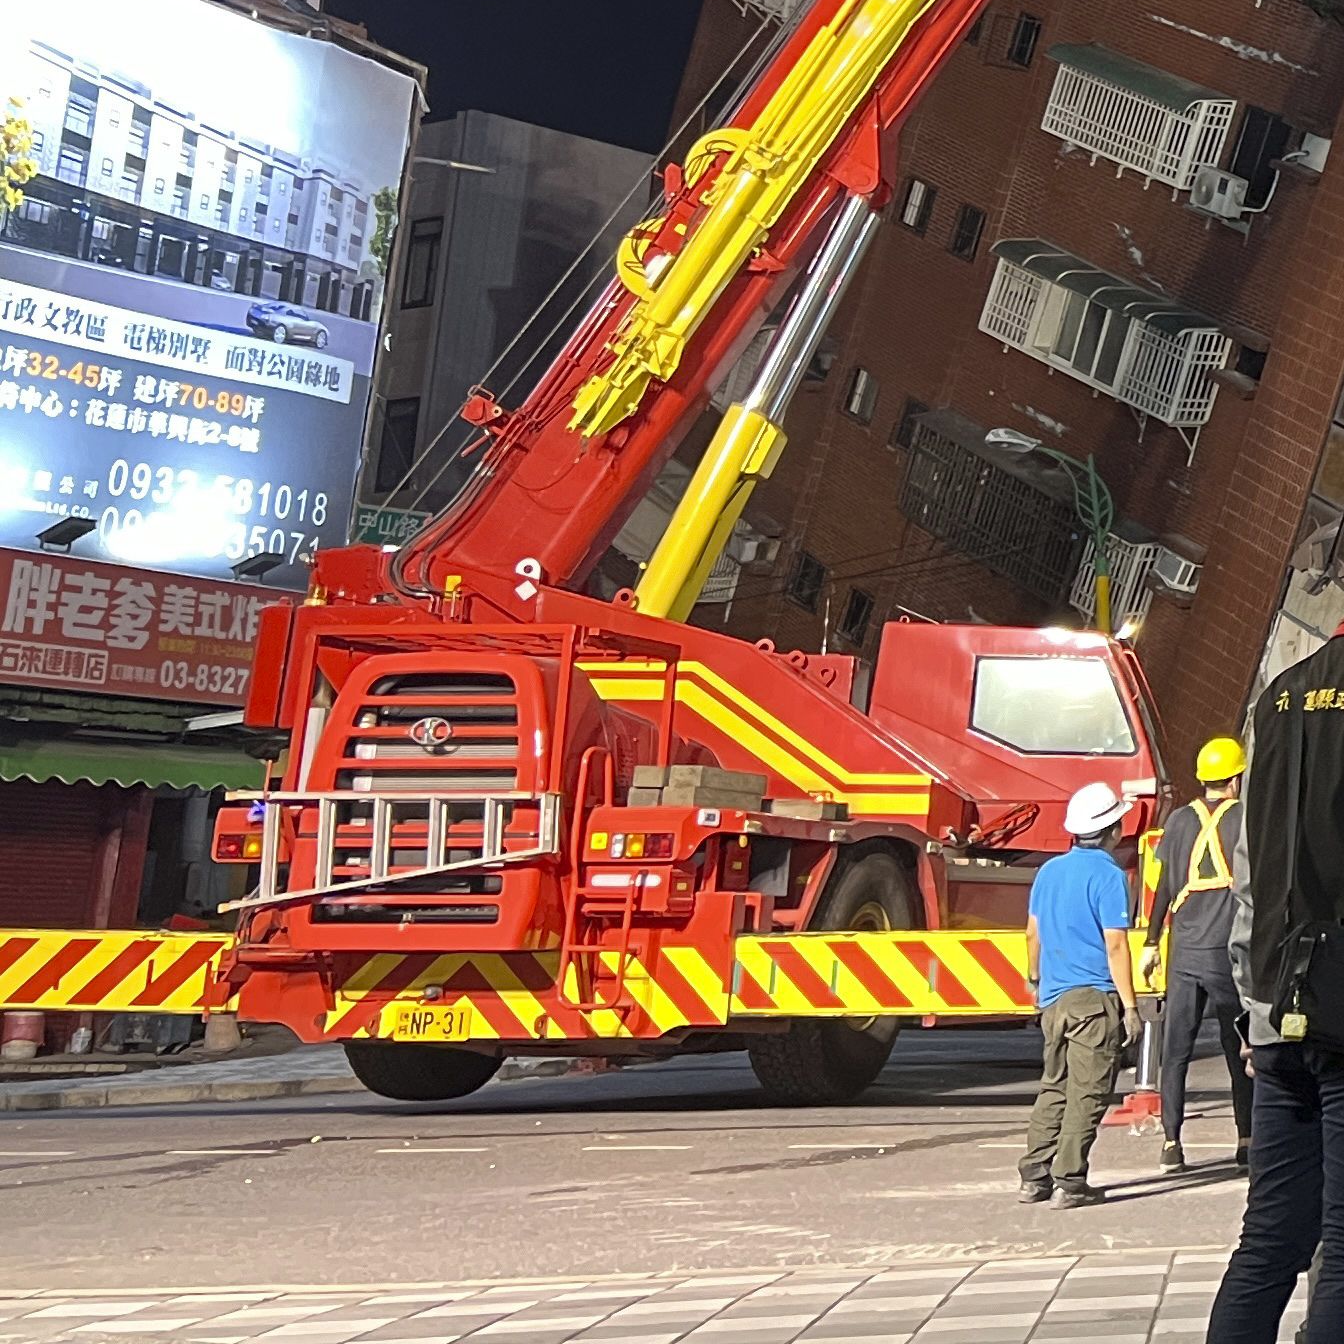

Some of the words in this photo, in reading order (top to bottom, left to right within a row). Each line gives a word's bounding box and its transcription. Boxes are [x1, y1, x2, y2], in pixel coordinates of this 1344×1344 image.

[0, 344, 123, 396] 坪32-45坪
[134, 373, 265, 423] 建坪70-89坪
[158, 583, 272, 643] 美式炸
[410, 1011, 465, 1036] NP-31
